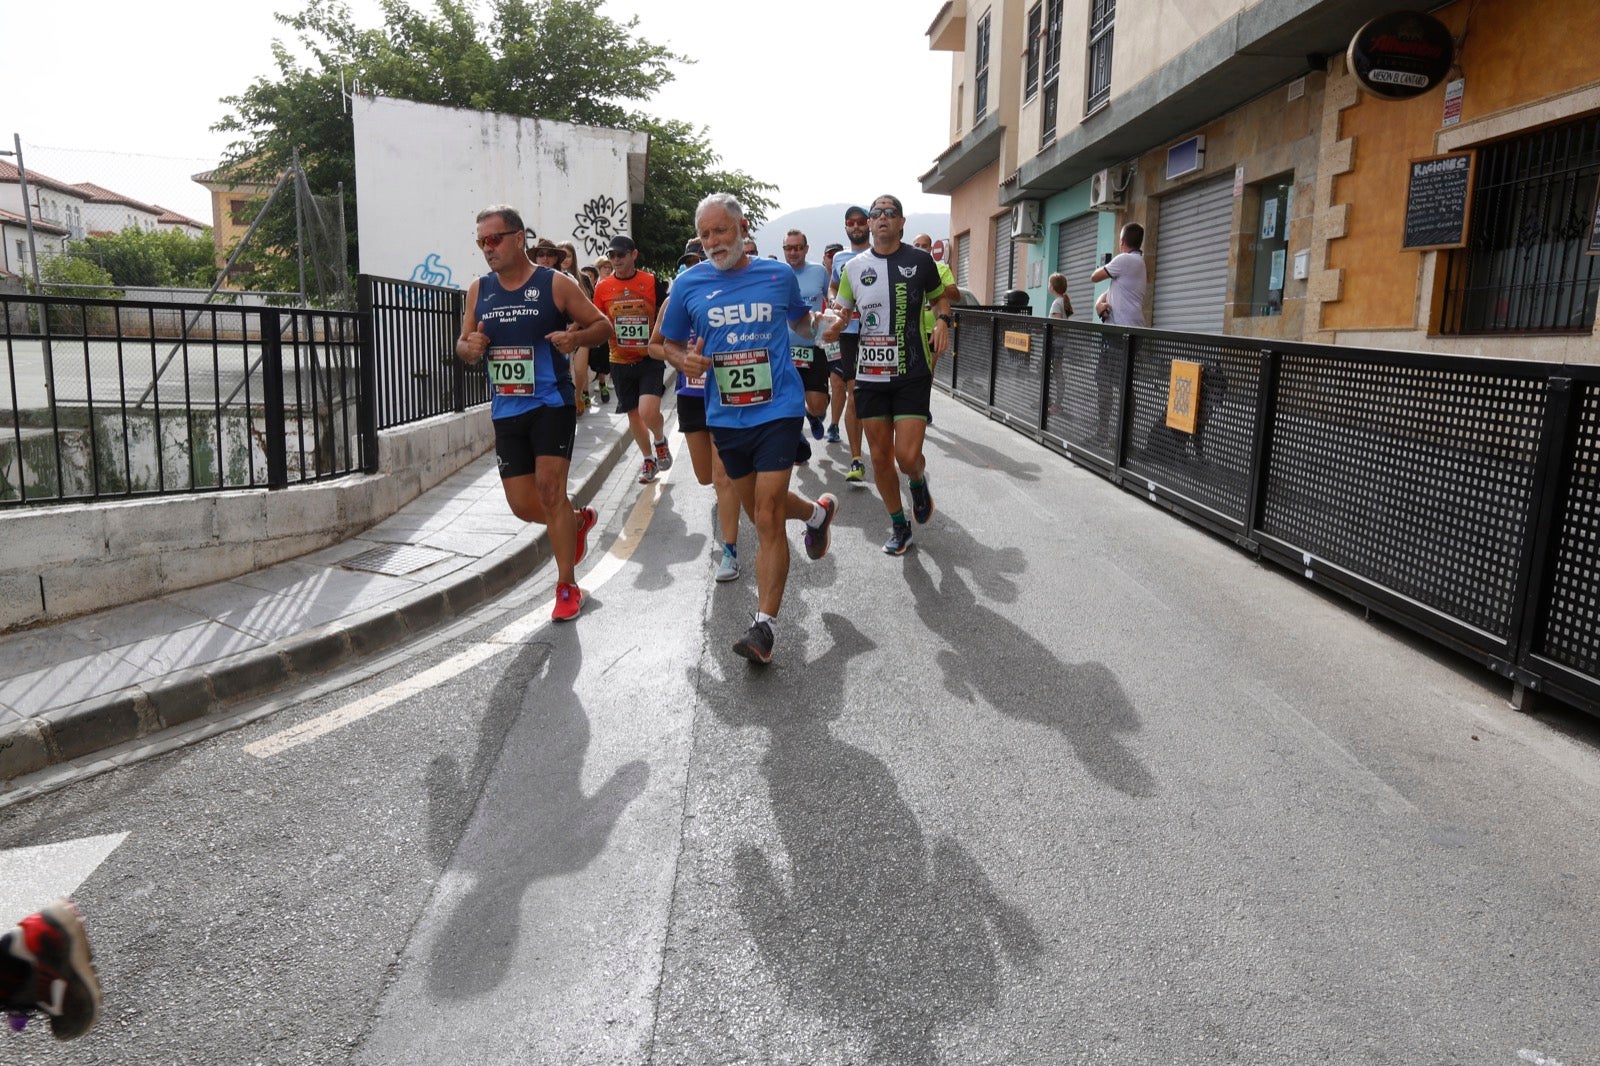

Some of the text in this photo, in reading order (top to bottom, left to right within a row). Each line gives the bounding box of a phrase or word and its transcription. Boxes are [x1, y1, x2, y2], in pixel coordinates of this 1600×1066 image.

[1373, 70, 1393, 81] MESON
[1400, 73, 1426, 87] CANTARO
[707, 303, 772, 328] SEUR
[895, 283, 907, 348] KAMPAMENTO
[621, 326, 643, 337] 291
[862, 348, 895, 362] 3050
[493, 363, 526, 381] 709
[729, 367, 756, 389] 25
